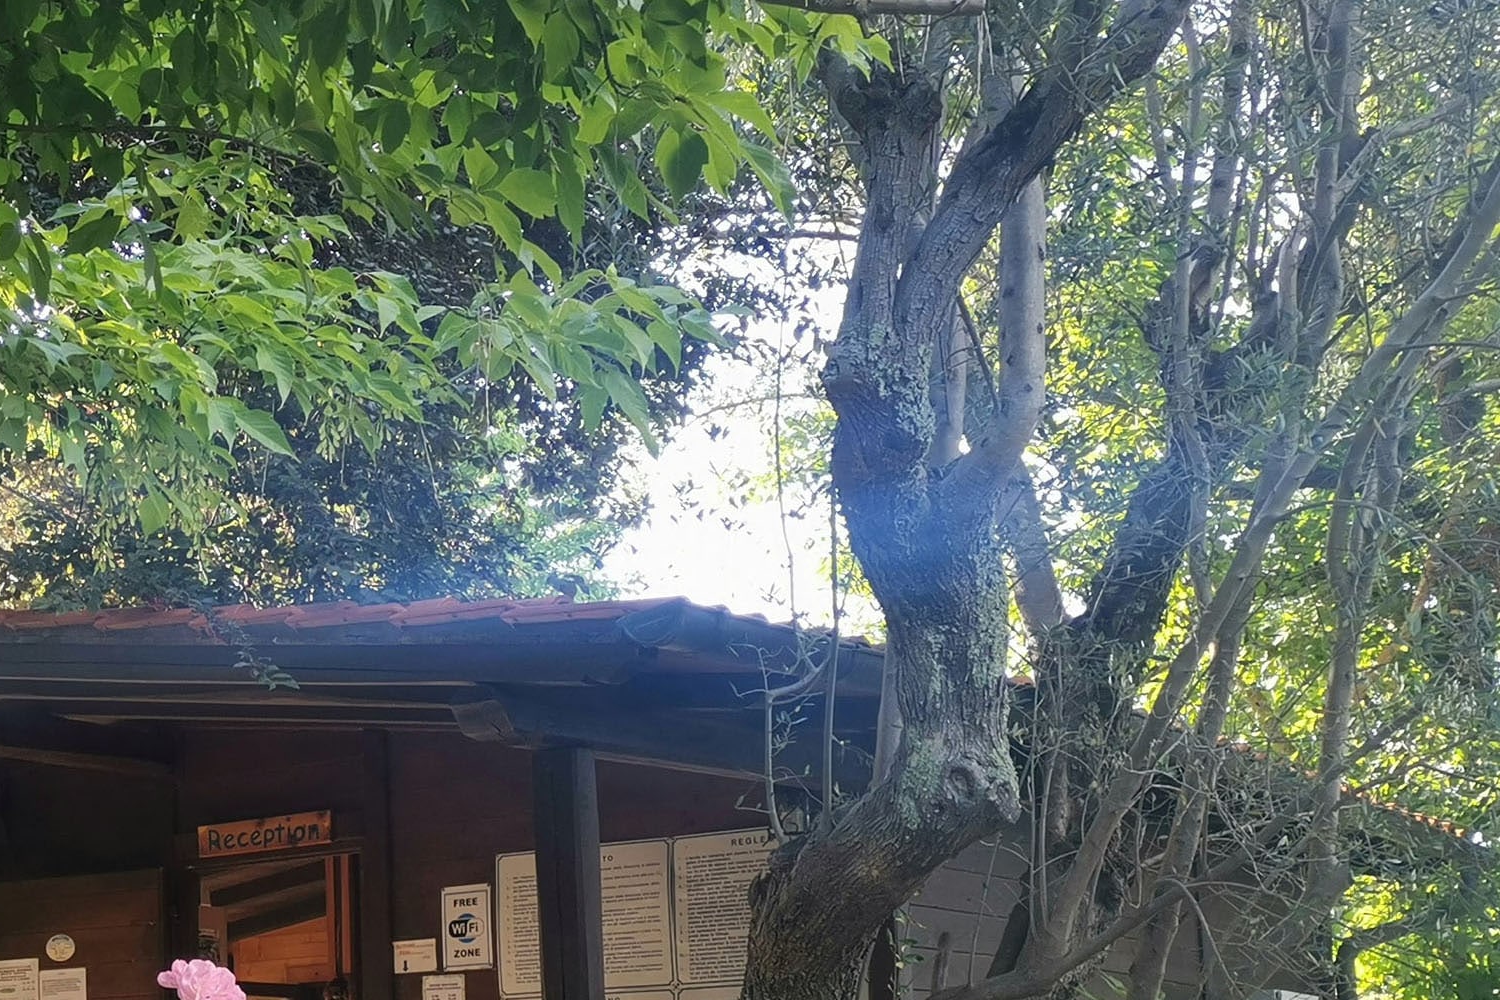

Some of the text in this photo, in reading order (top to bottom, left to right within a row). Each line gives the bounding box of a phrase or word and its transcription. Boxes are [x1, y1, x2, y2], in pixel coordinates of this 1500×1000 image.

[208, 823, 320, 851] Reception
[731, 836, 765, 846] REGLE
[453, 897, 478, 907] FREE
[454, 948, 480, 958] ZONE
